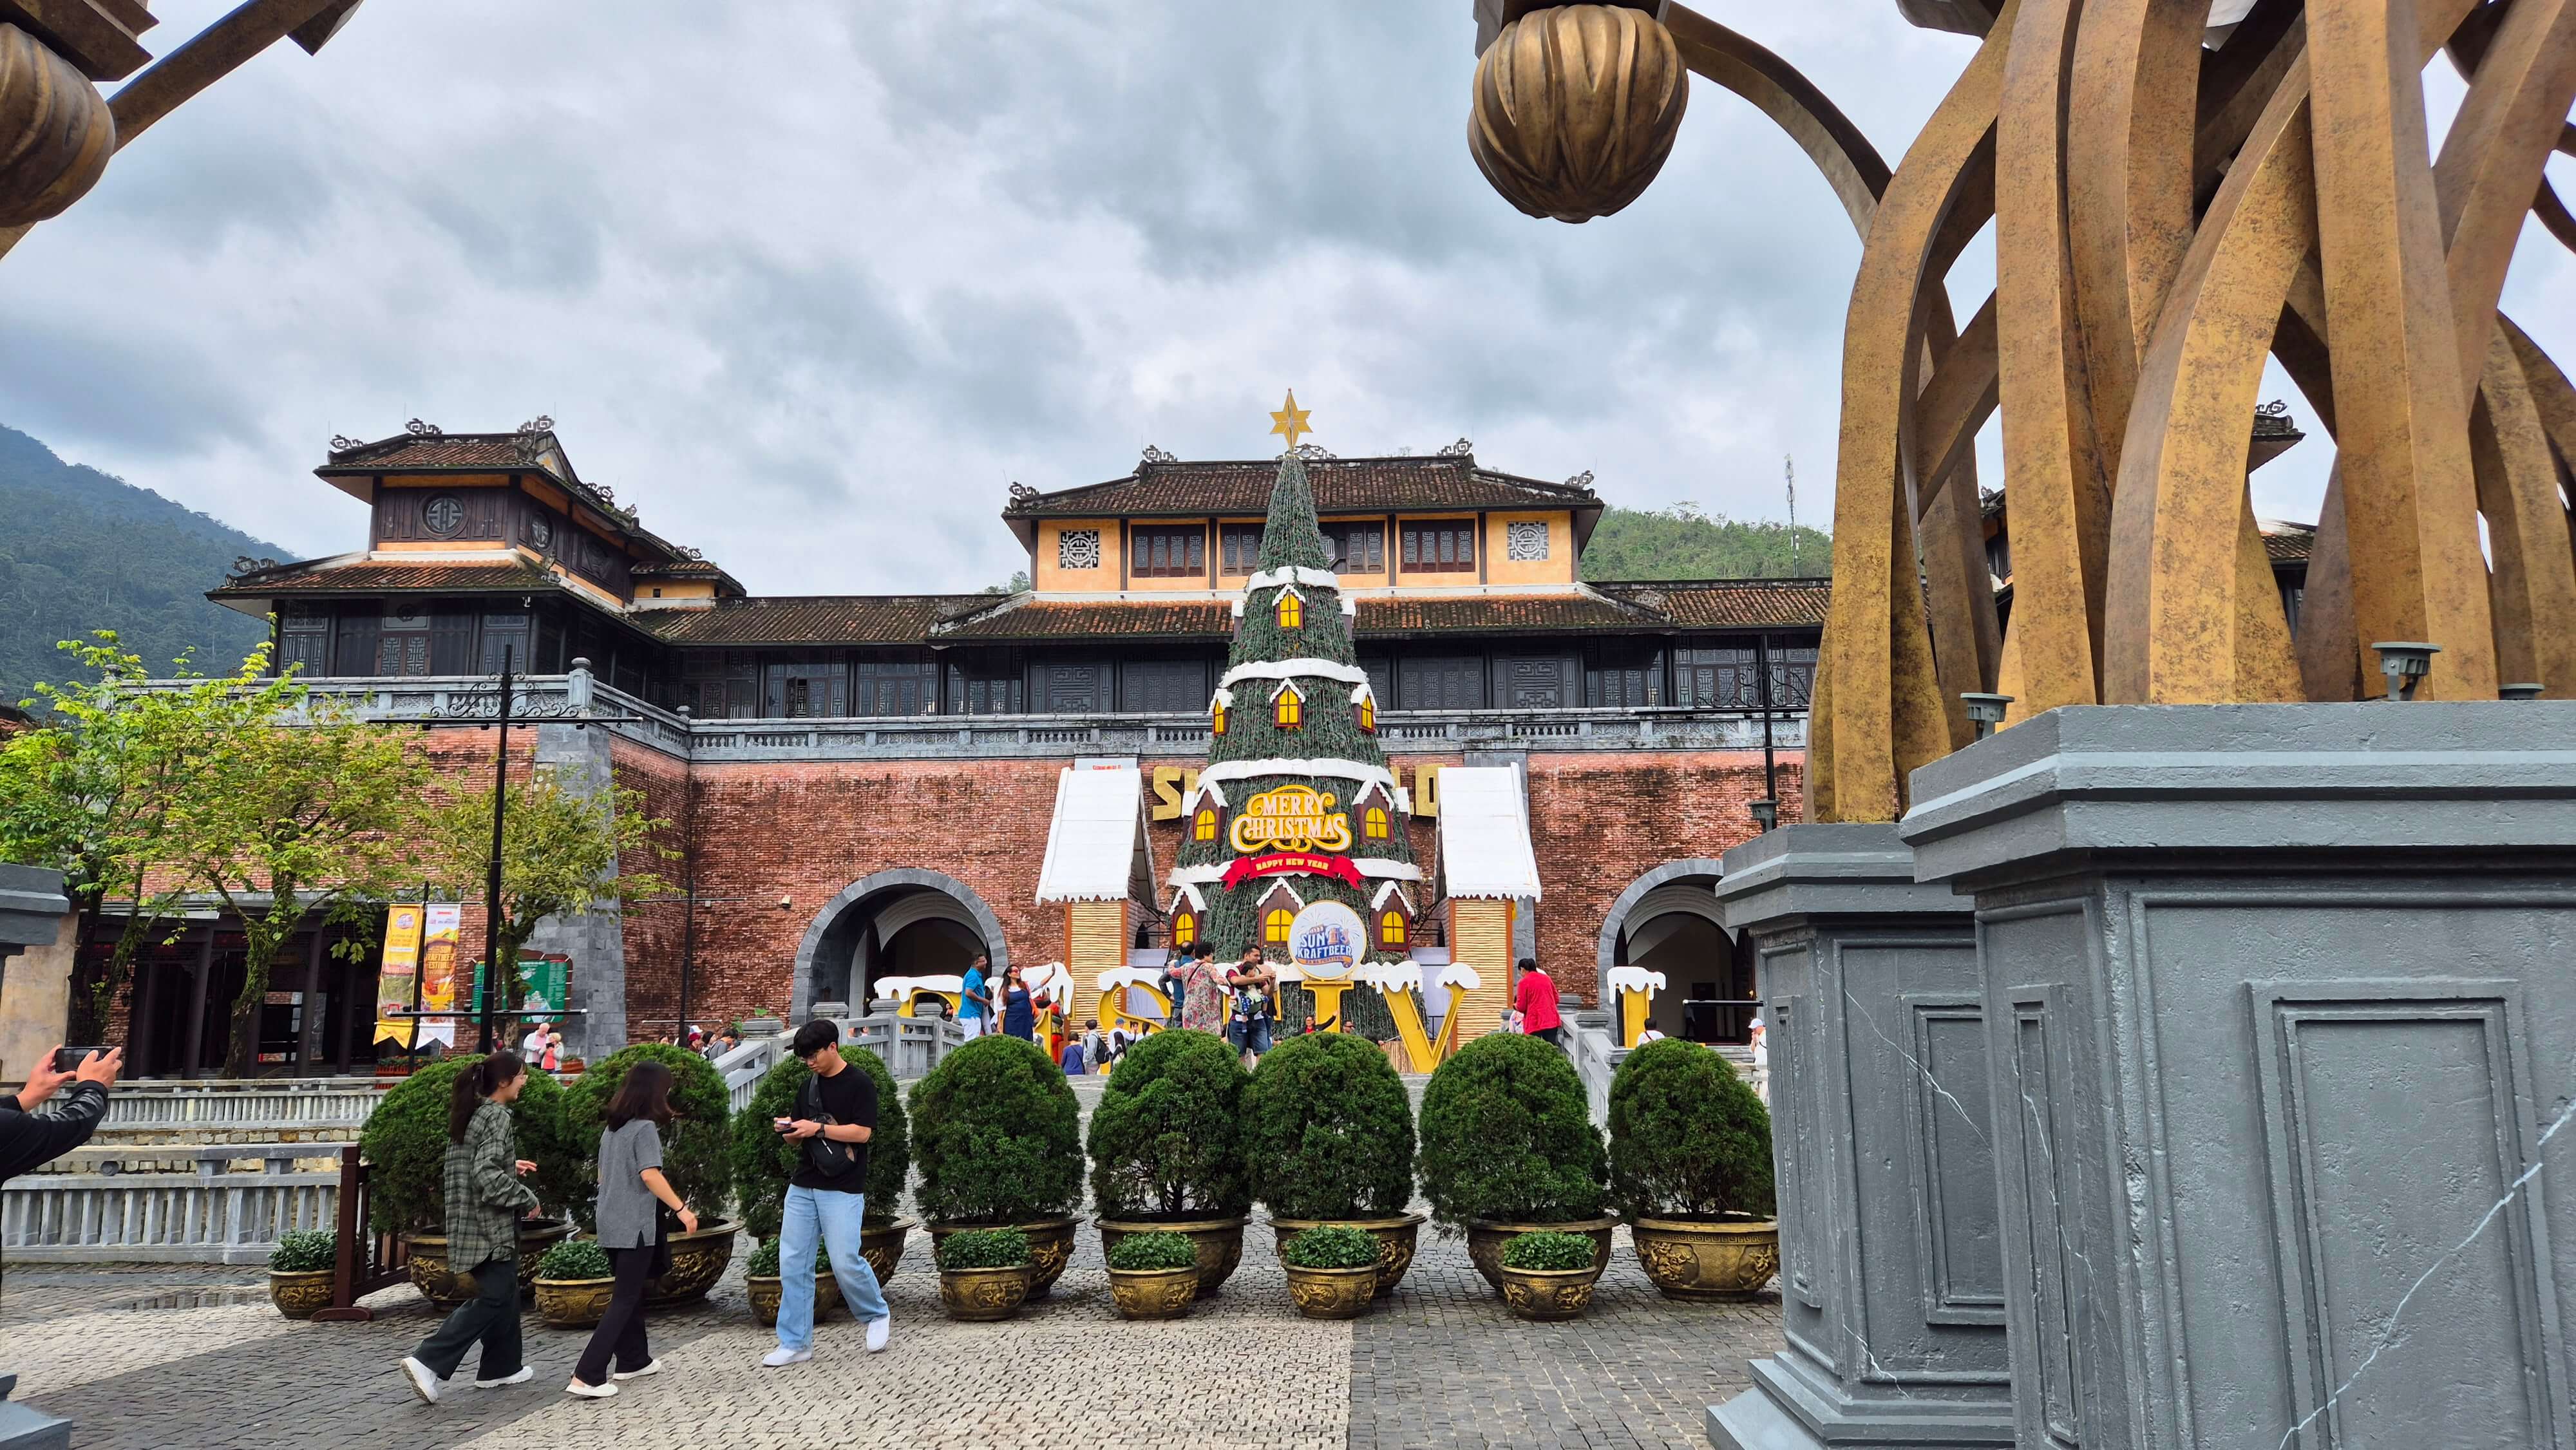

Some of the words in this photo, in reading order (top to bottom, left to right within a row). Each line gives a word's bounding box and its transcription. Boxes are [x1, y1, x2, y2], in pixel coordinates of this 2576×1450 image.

[1247, 785, 1336, 817] MERRY
[1229, 813, 1352, 854] CHRISTMAS
[1256, 858, 1283, 871] HAPPY
[1285, 858, 1305, 866] NEW
[1307, 859, 1329, 871] YEAR
[1300, 932, 1325, 948] SUN
[1297, 944, 1352, 959] KRAFTBEER
